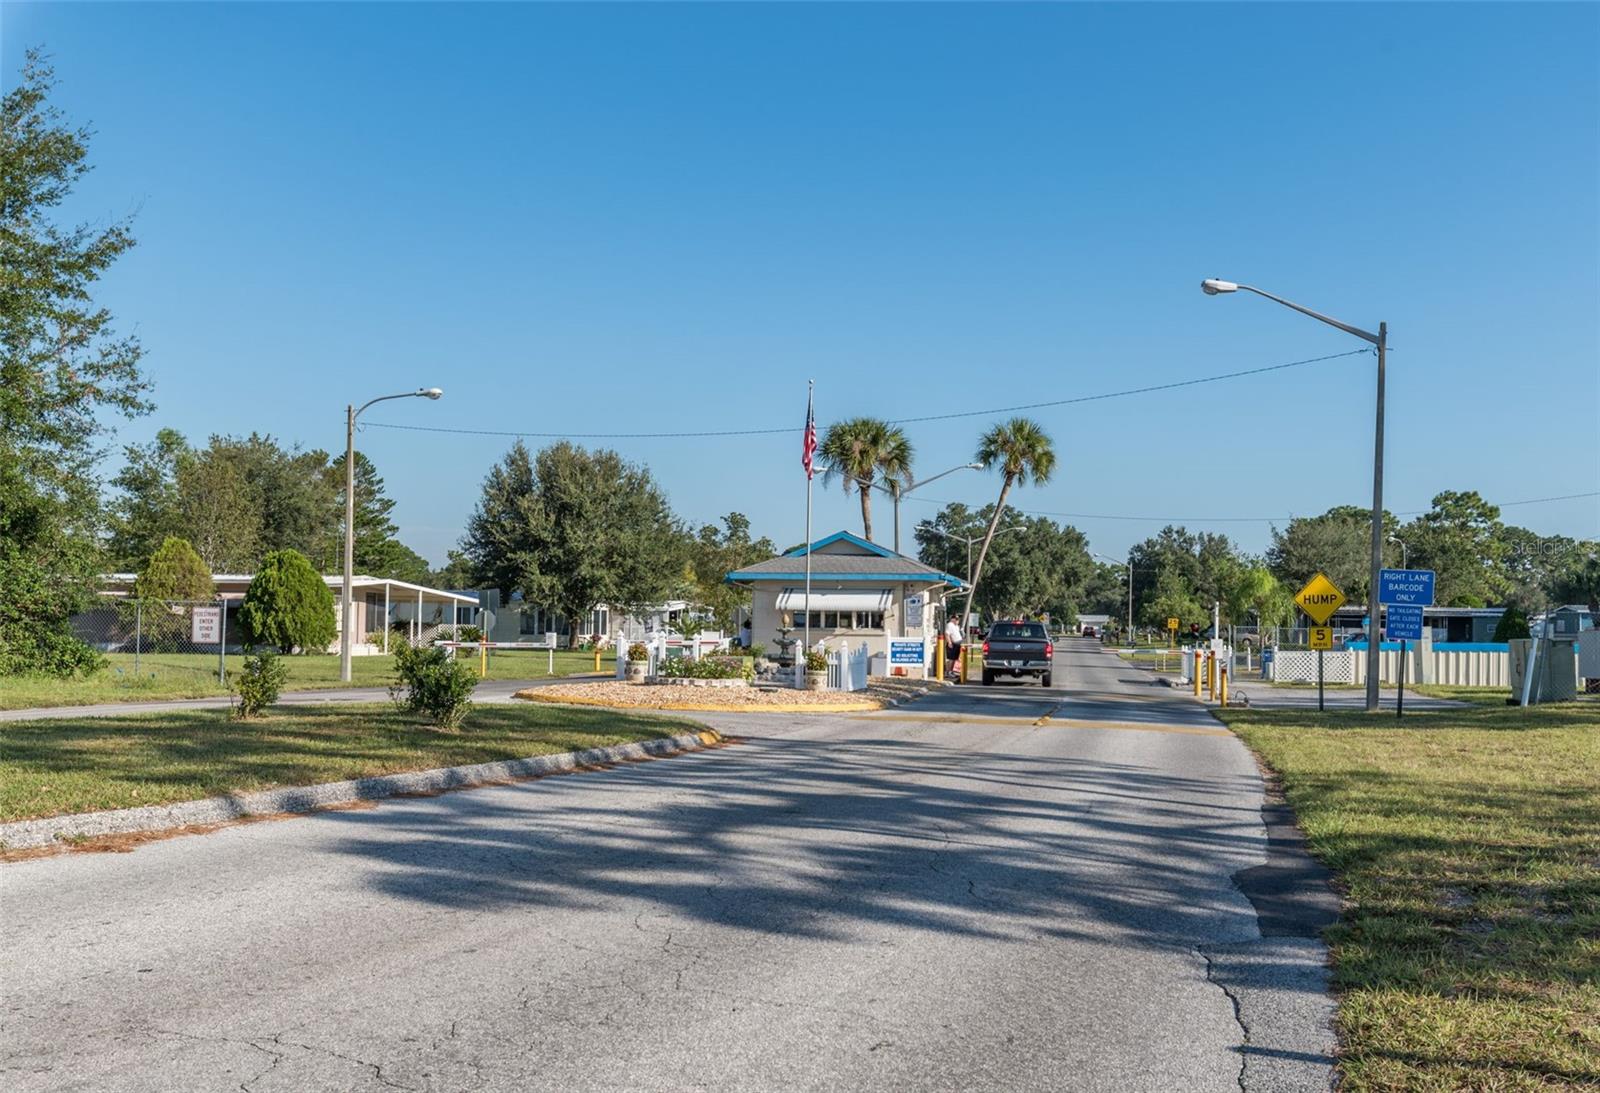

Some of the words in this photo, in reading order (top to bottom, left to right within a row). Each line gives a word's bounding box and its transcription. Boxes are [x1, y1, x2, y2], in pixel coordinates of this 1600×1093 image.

[1383, 573, 1406, 581] RIGHT
[1409, 574, 1430, 582] LANE
[1388, 583, 1424, 592] BARCODE
[1303, 594, 1338, 605] HUMP
[1395, 594, 1416, 602] ONLY
[1316, 629, 1326, 641] 5
